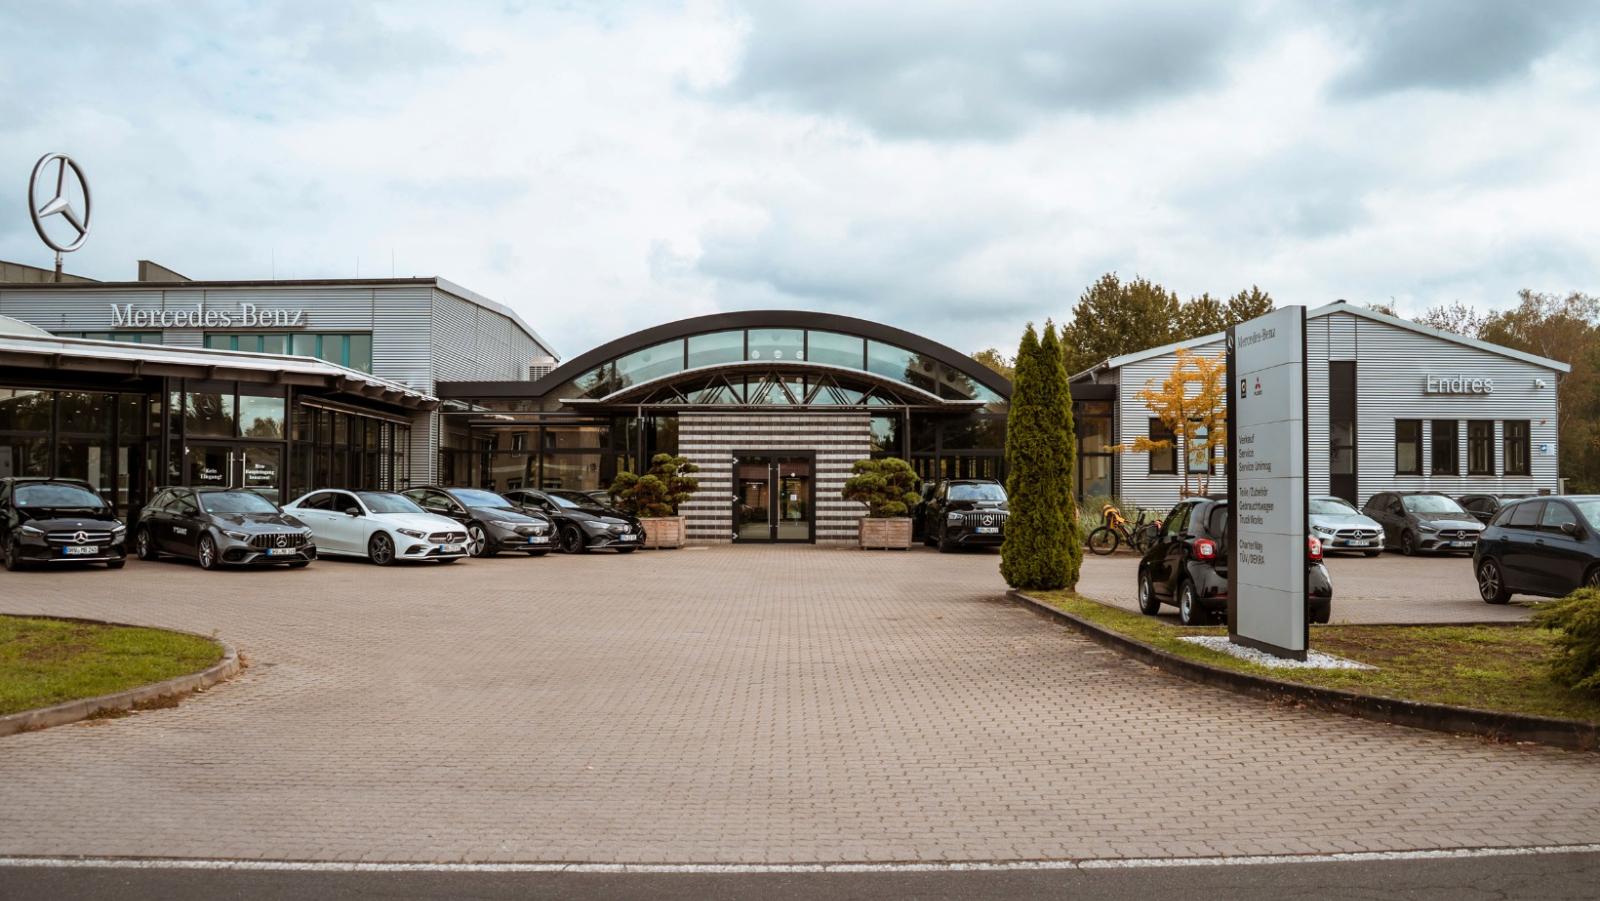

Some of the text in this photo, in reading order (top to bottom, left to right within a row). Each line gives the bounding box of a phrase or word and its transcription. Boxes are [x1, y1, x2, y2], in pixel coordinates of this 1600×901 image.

[110, 303, 305, 328] Mercedes-Benz
[1237, 328, 1276, 349] Mercedes-Benz
[1426, 373, 1494, 393] Endres
[1238, 433, 1255, 445] Verkauf
[1238, 448, 1255, 458] Service
[1238, 461, 1272, 473] Service Unimog
[1239, 501, 1274, 513] Gebrauchtwagen
